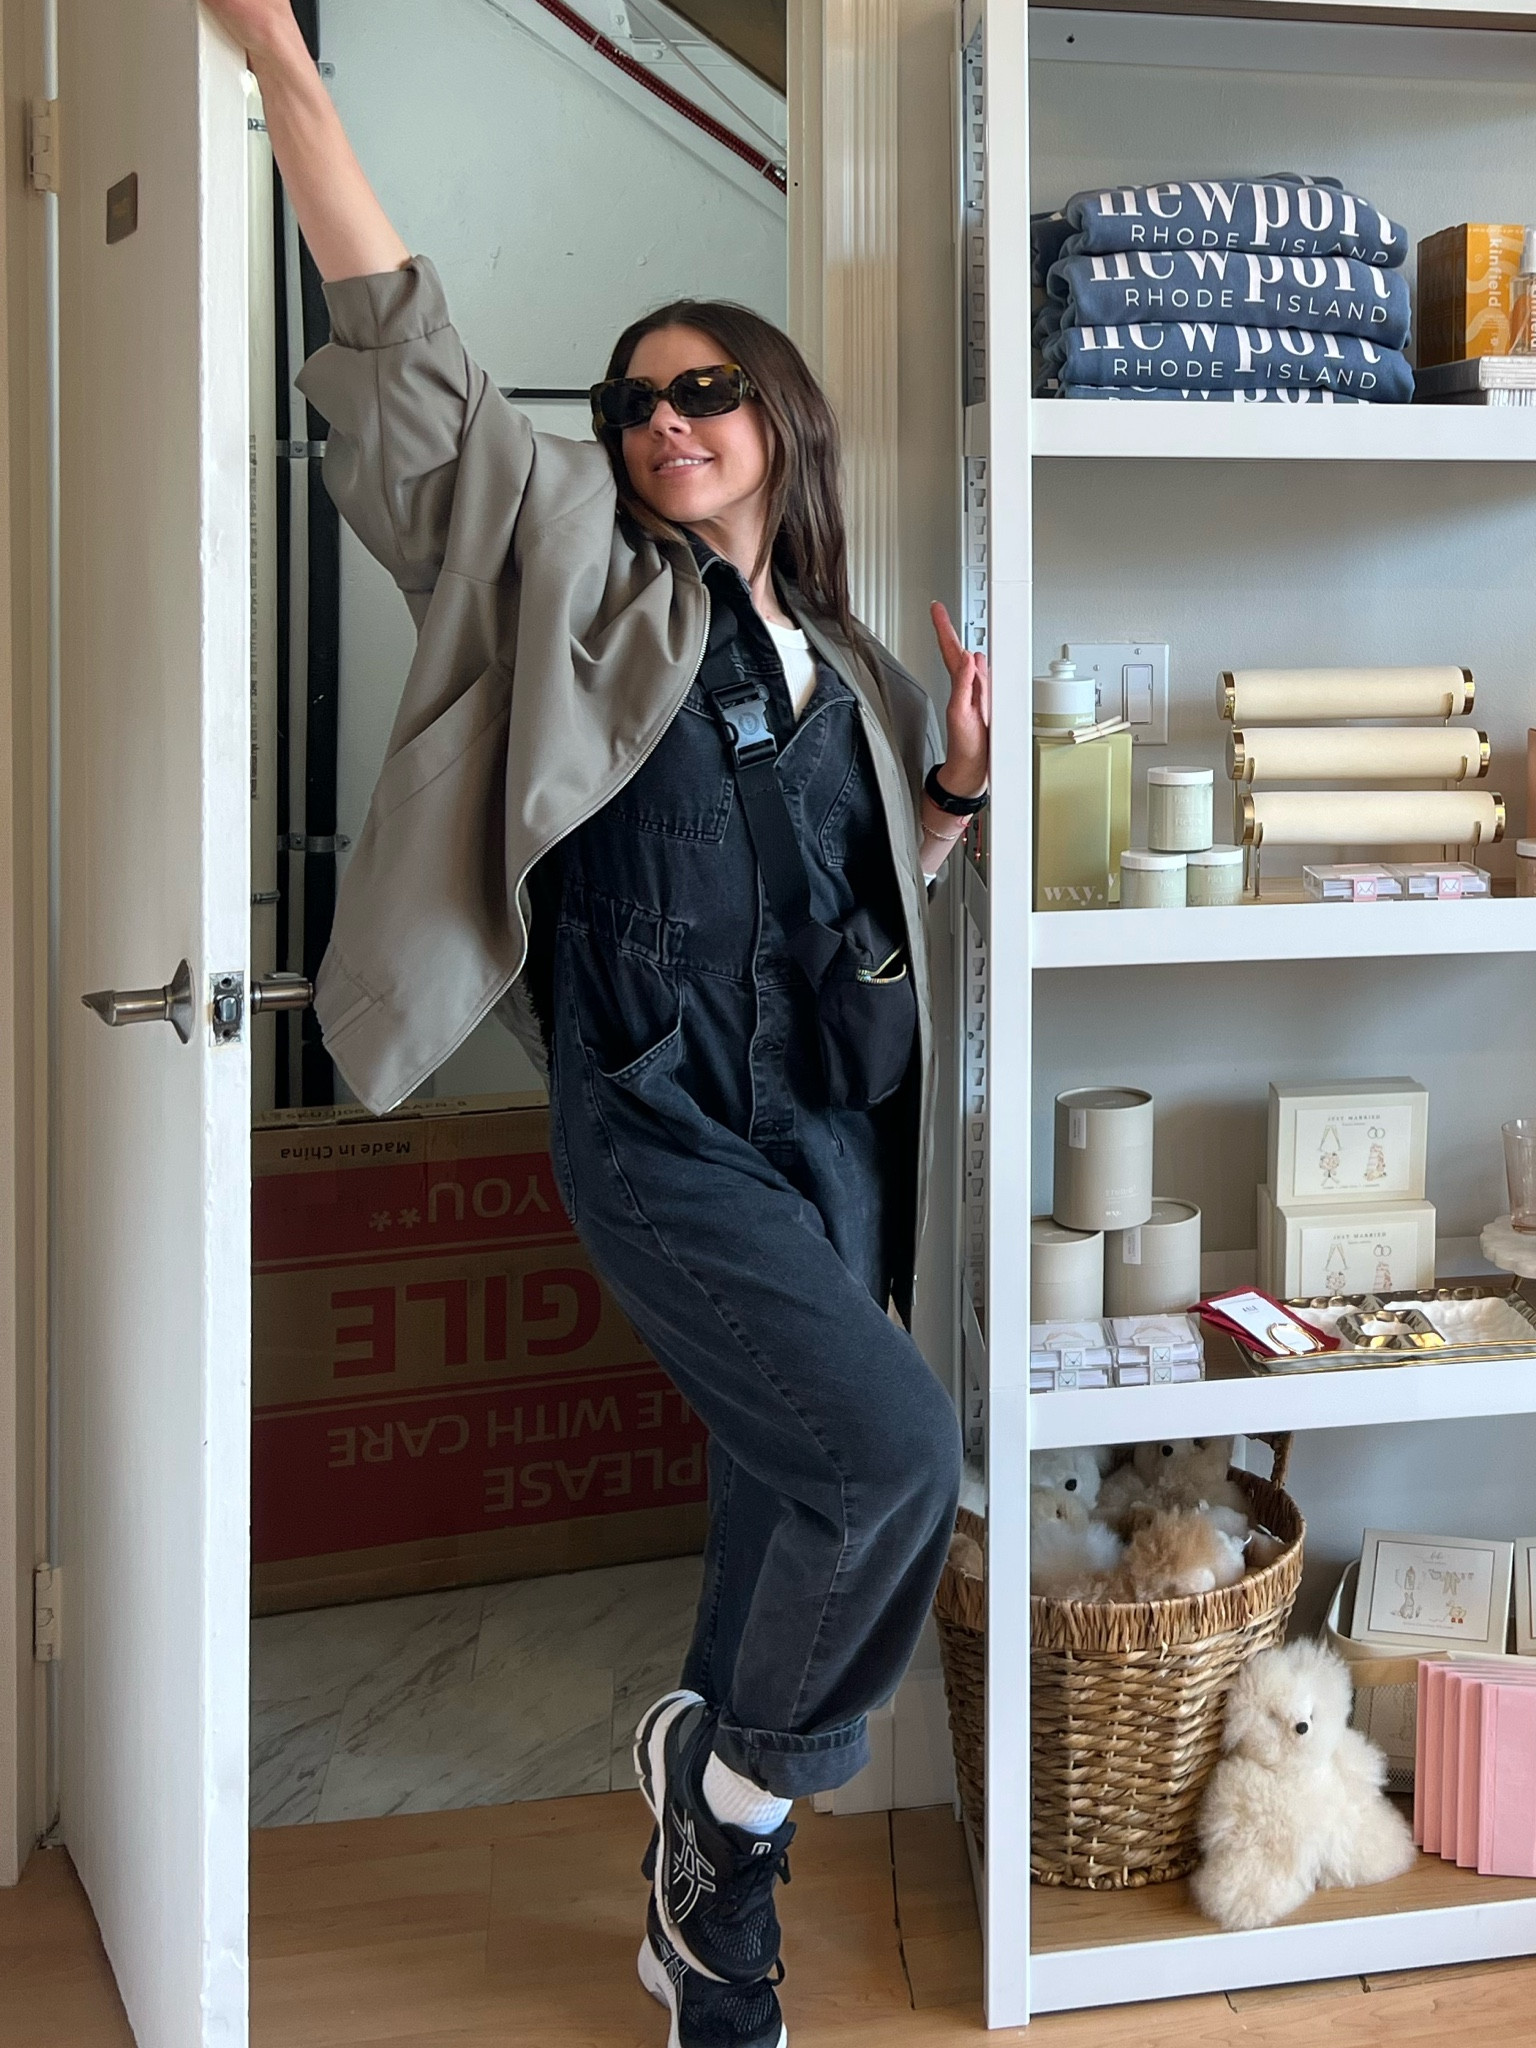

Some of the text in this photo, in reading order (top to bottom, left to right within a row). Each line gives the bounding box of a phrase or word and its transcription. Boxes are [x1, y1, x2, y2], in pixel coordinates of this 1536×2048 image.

[1097, 181, 1397, 246] newport
[1131, 224, 1389, 263] RHODE ISLAND
[1488, 237, 1502, 308] kinfield
[1125, 288, 1388, 323] RHODE ISLAND
[1113, 358, 1378, 389] RHODE ISLAND
[280, 1145, 333, 1161] China
[361, 1141, 411, 1156] Made
[330, 1267, 602, 1380] GILE
[326, 1414, 470, 1469] CARE
[487, 1393, 621, 1448] WITH
[483, 1446, 703, 1513] PLEASE
